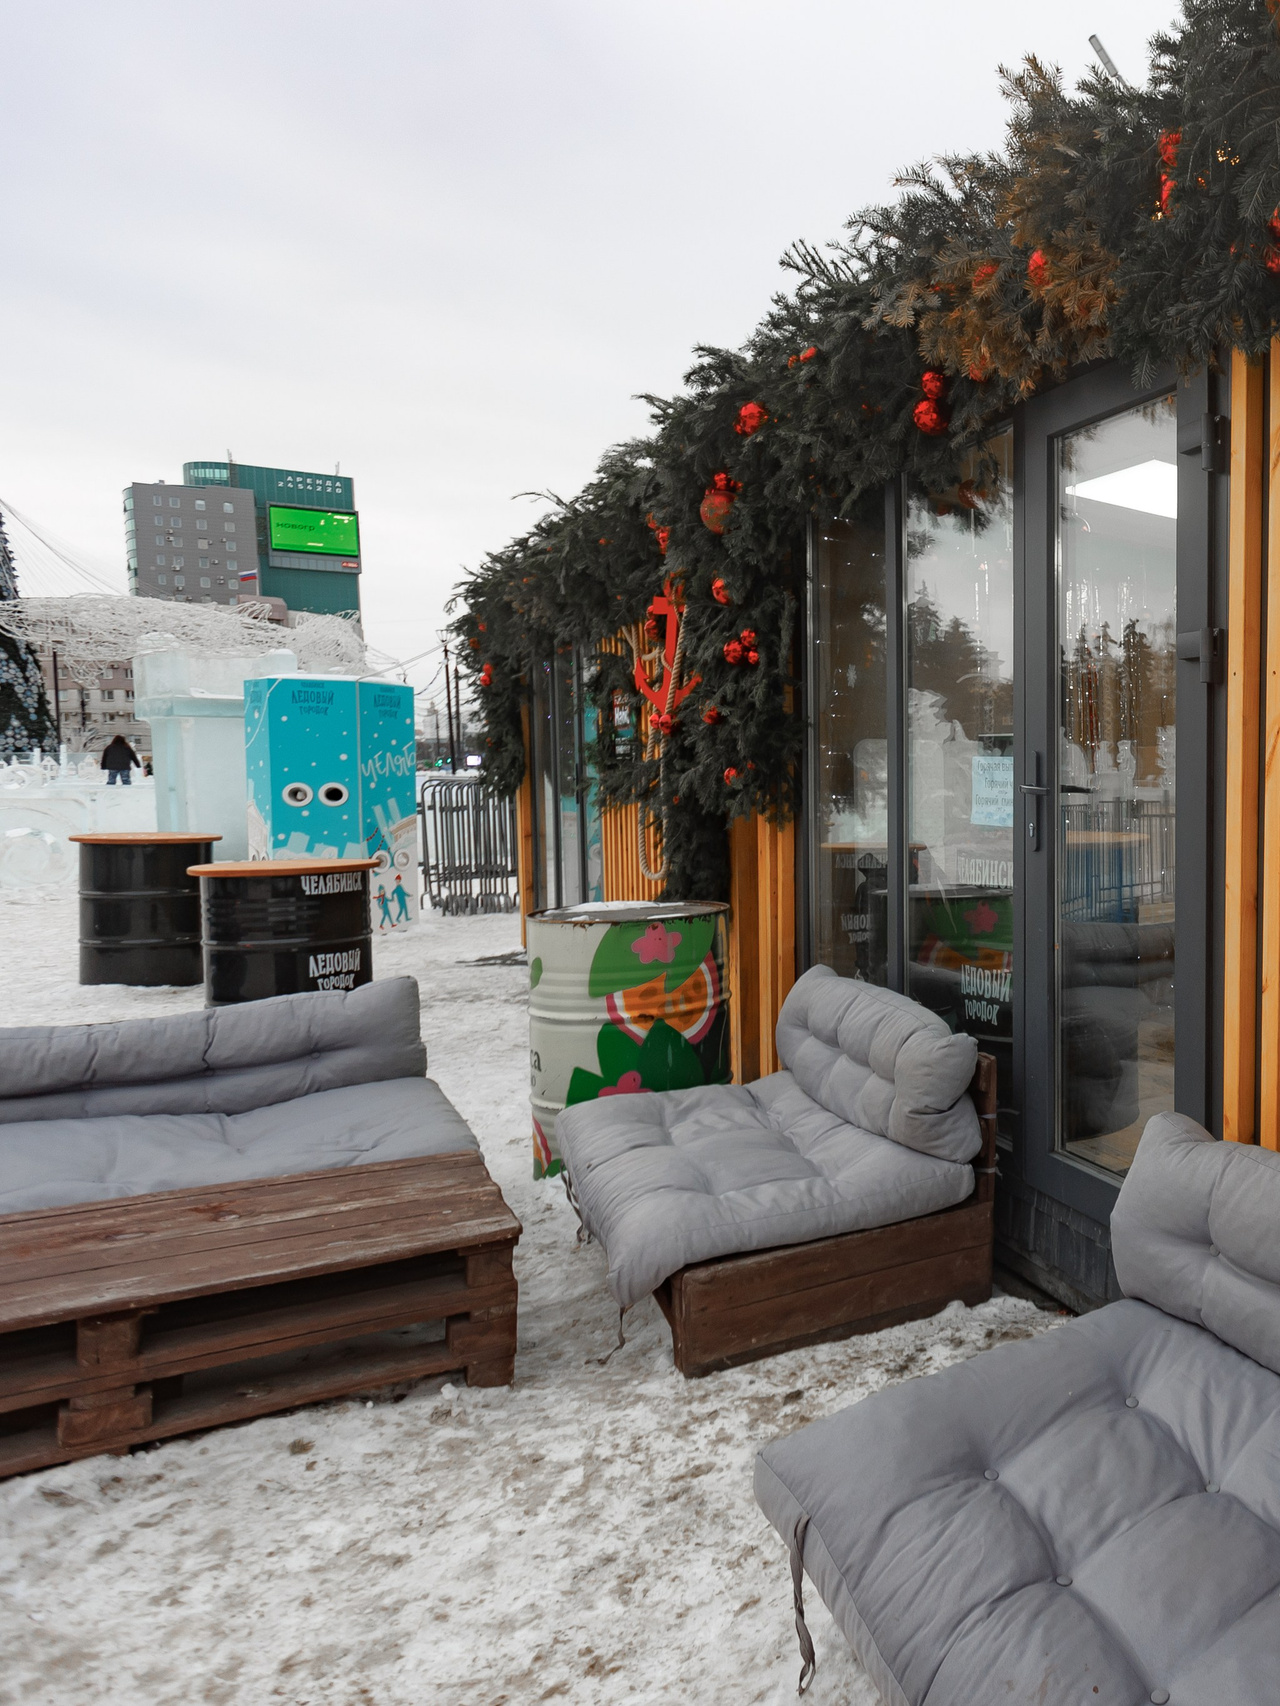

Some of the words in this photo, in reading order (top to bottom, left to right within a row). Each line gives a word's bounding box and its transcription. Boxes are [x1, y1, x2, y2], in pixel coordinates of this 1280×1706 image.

[286, 476, 342, 487] АРЕНДА
[291, 689, 335, 706] ЛЕДОВЫЙ
[298, 705, 330, 716] ГОРОДОК
[301, 872, 362, 895] ЧЕЛЯБИНСК
[309, 948, 361, 978] ЛЕДОВЫЙ
[317, 973, 355, 991] ГОРОДОК
[961, 964, 1012, 1003] ЛЕДОВЫЙ
[964, 998, 1000, 1026] ГОРОДОК
